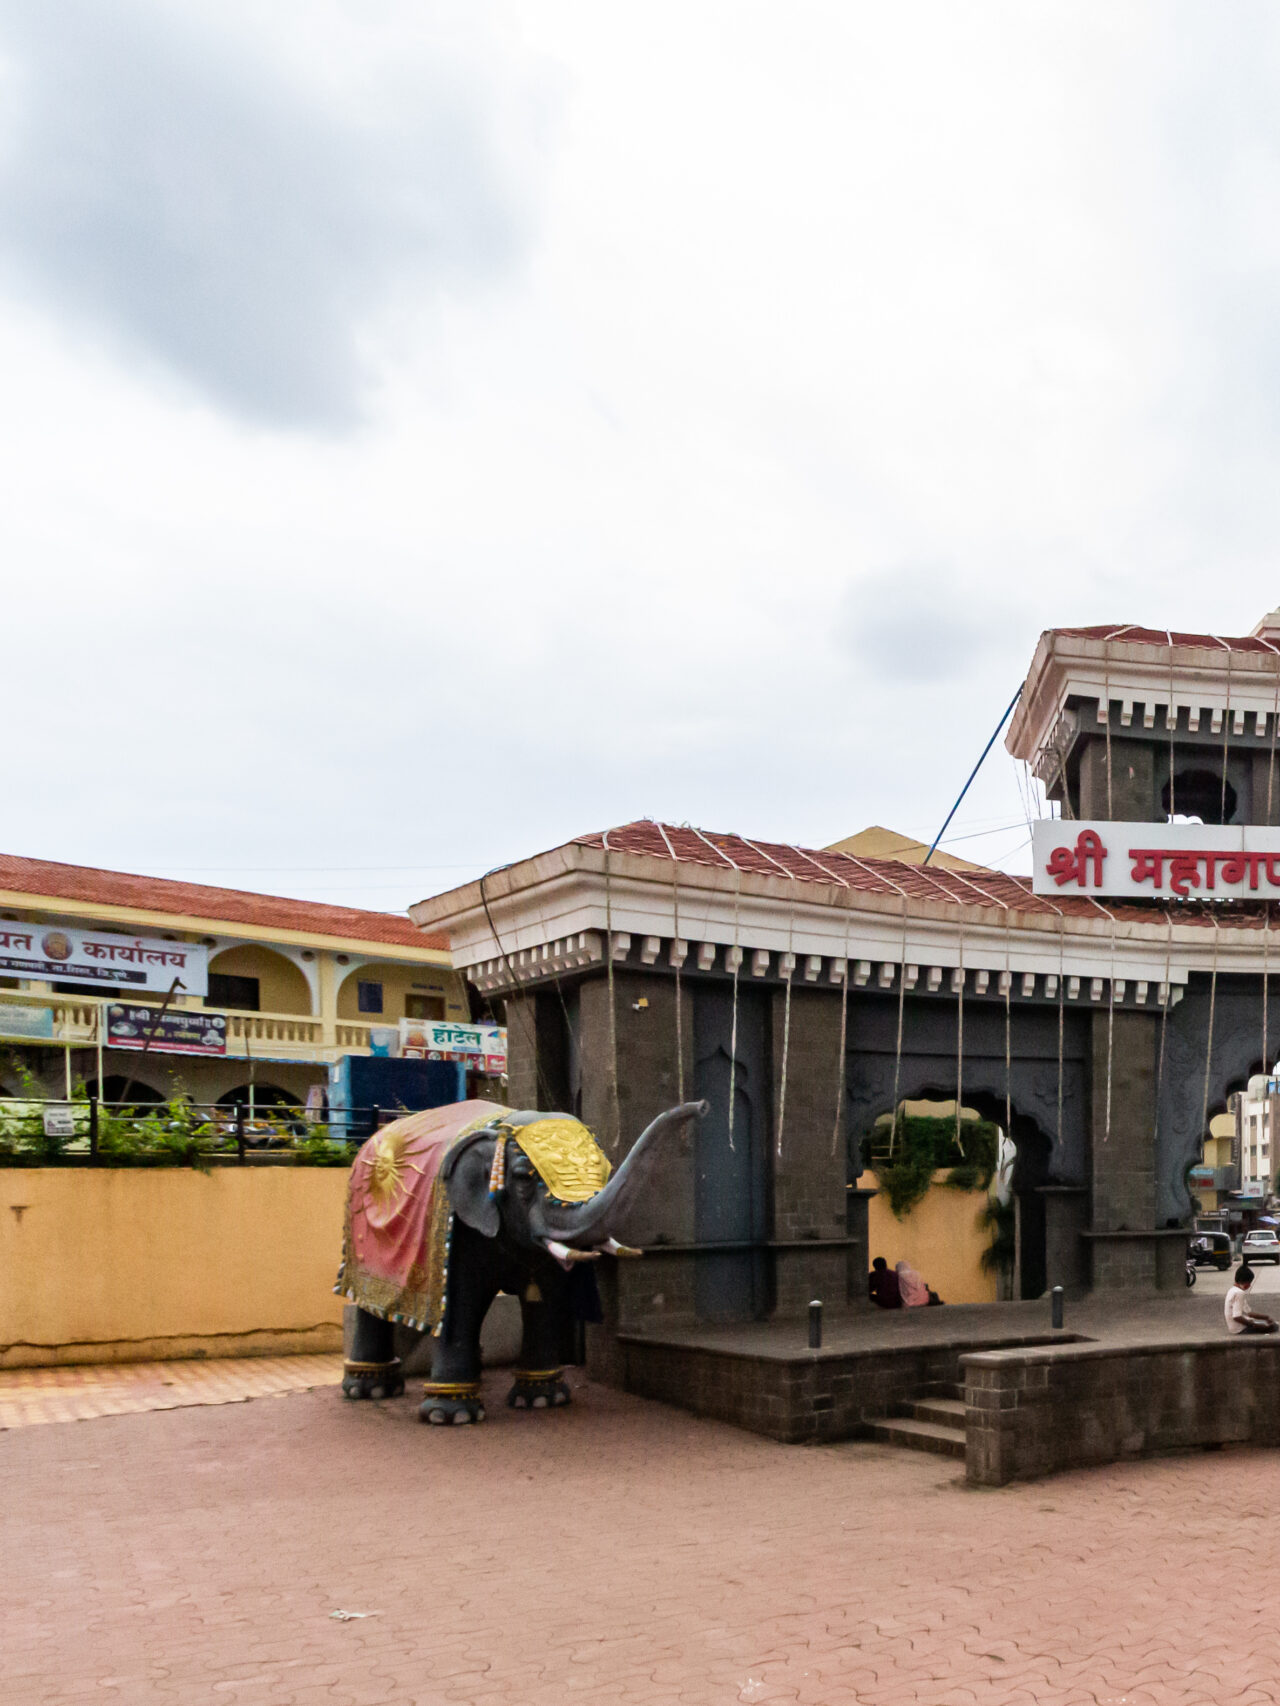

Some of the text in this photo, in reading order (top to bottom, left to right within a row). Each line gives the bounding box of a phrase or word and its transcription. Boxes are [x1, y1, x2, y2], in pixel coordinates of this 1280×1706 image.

[1046, 829, 1107, 887] श्री
[82, 940, 187, 969] कार्यालय
[432, 1024, 482, 1046] हॉटेल
